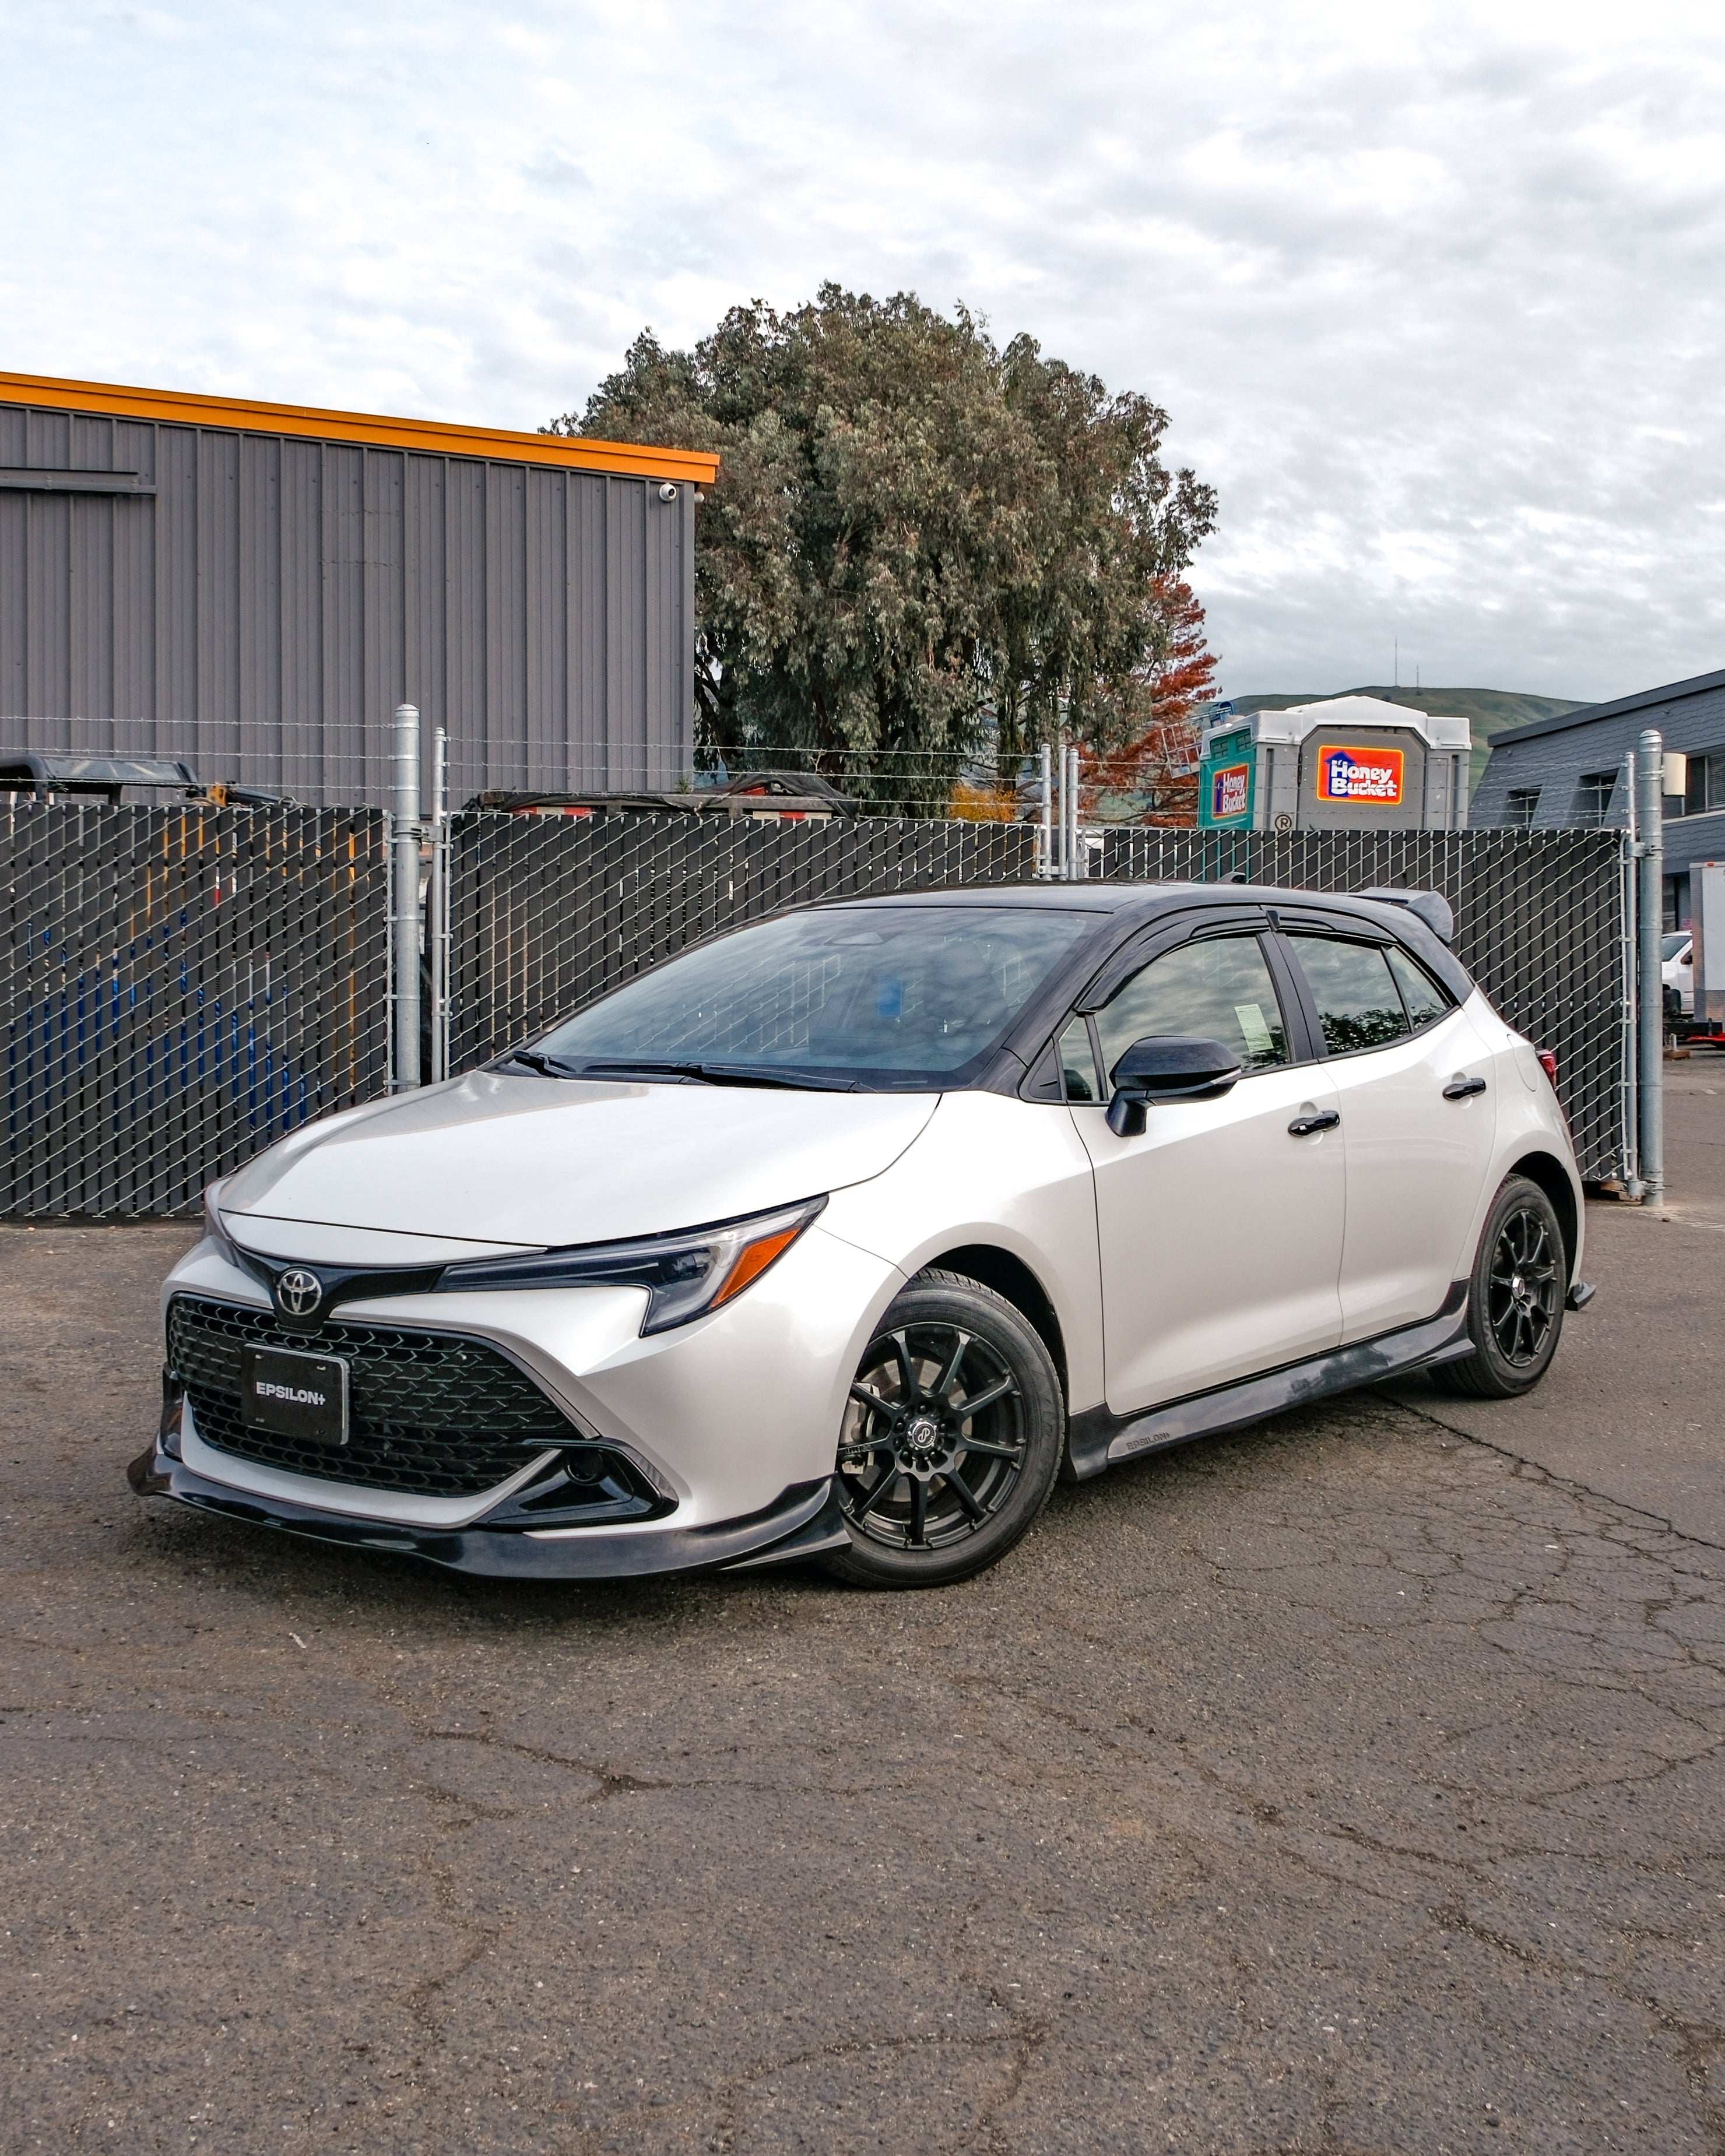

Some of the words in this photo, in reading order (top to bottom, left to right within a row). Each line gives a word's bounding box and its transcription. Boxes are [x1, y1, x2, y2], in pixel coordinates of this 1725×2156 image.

[1223, 773, 1245, 794] Honey
[1331, 759, 1392, 784] Honey
[1331, 778, 1397, 797] Bucket
[1222, 789, 1246, 813] Bucket
[256, 1381, 326, 1405] EPSILON+
